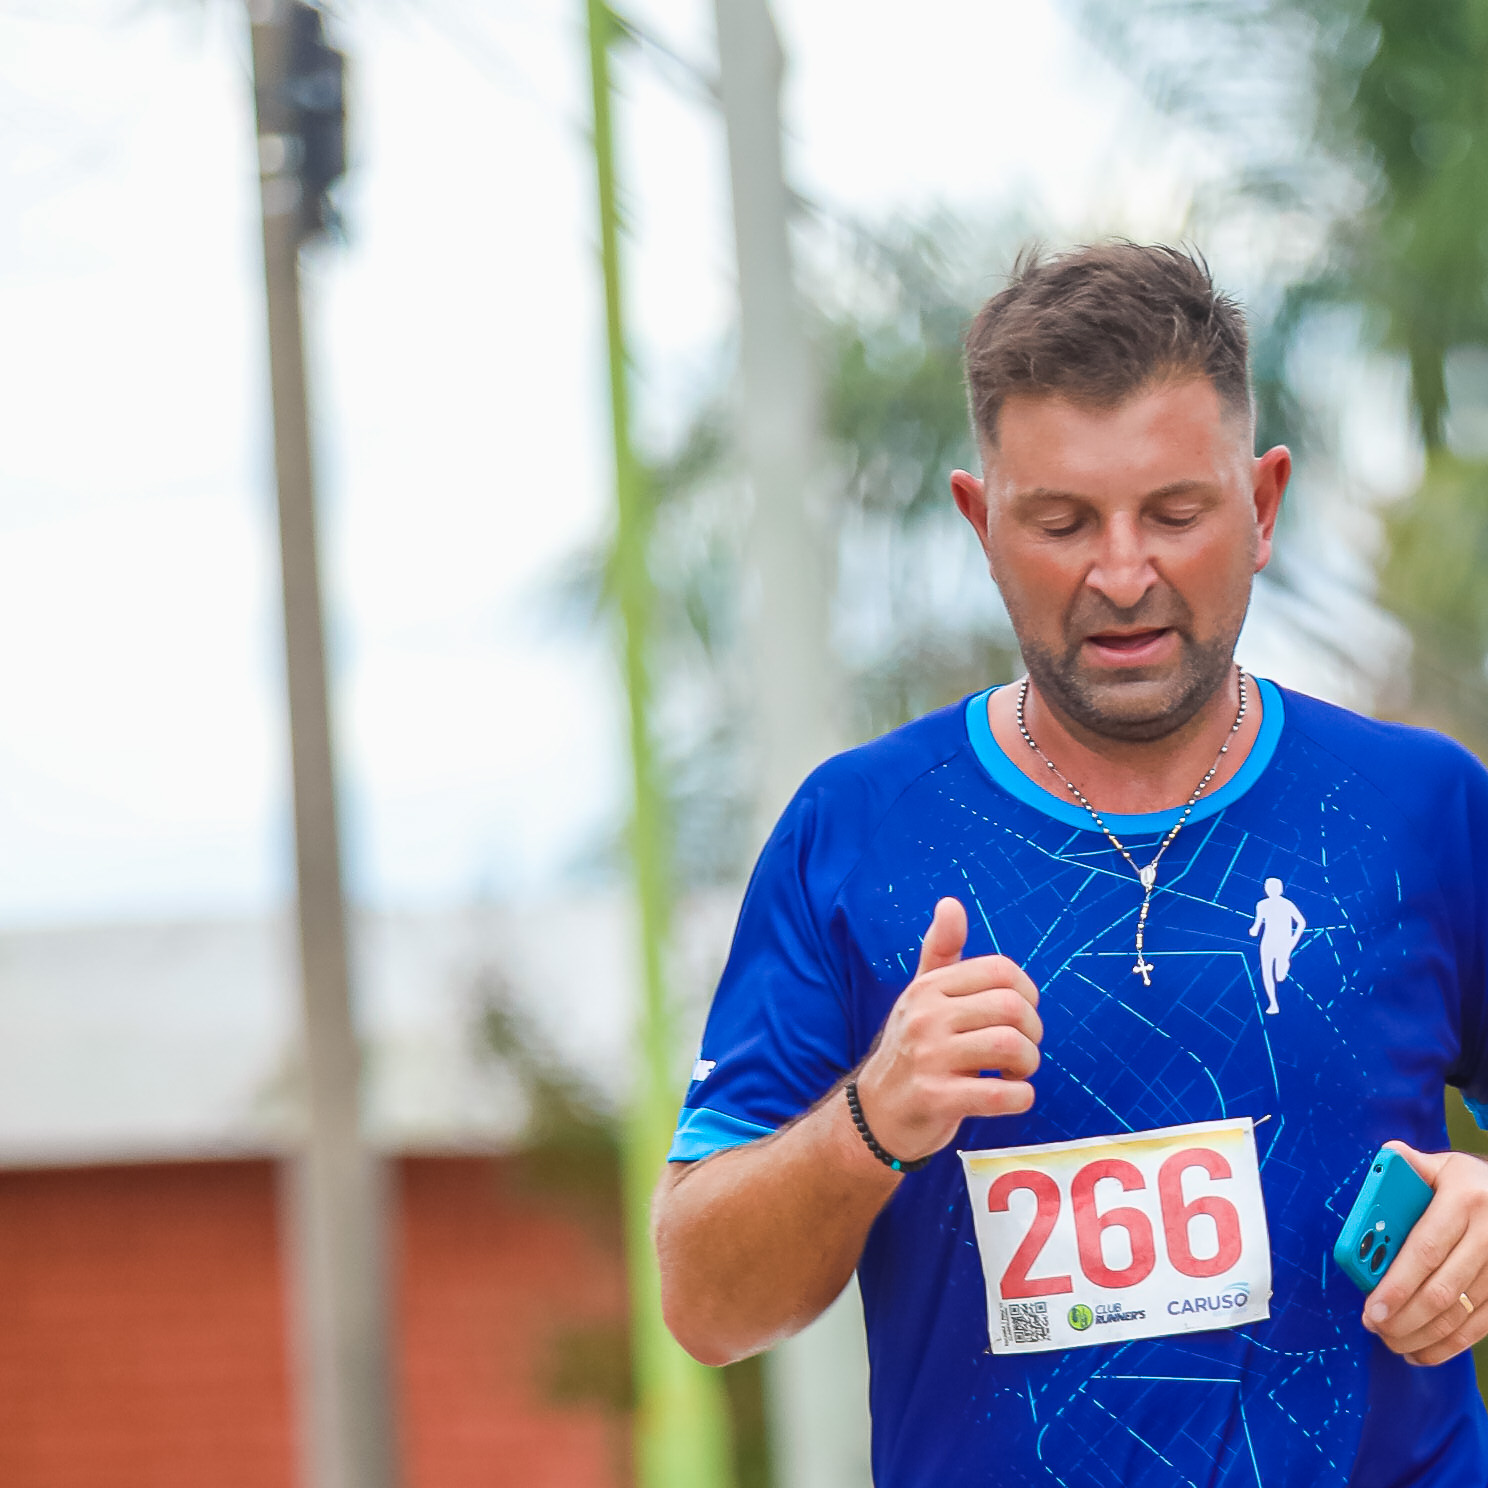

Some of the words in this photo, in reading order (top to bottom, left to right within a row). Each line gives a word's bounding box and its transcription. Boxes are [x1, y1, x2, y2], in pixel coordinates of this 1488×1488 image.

[988, 1148, 1242, 1300] 266
[1095, 1303, 1122, 1314] CLUB
[1167, 1293, 1248, 1315] CARUSO
